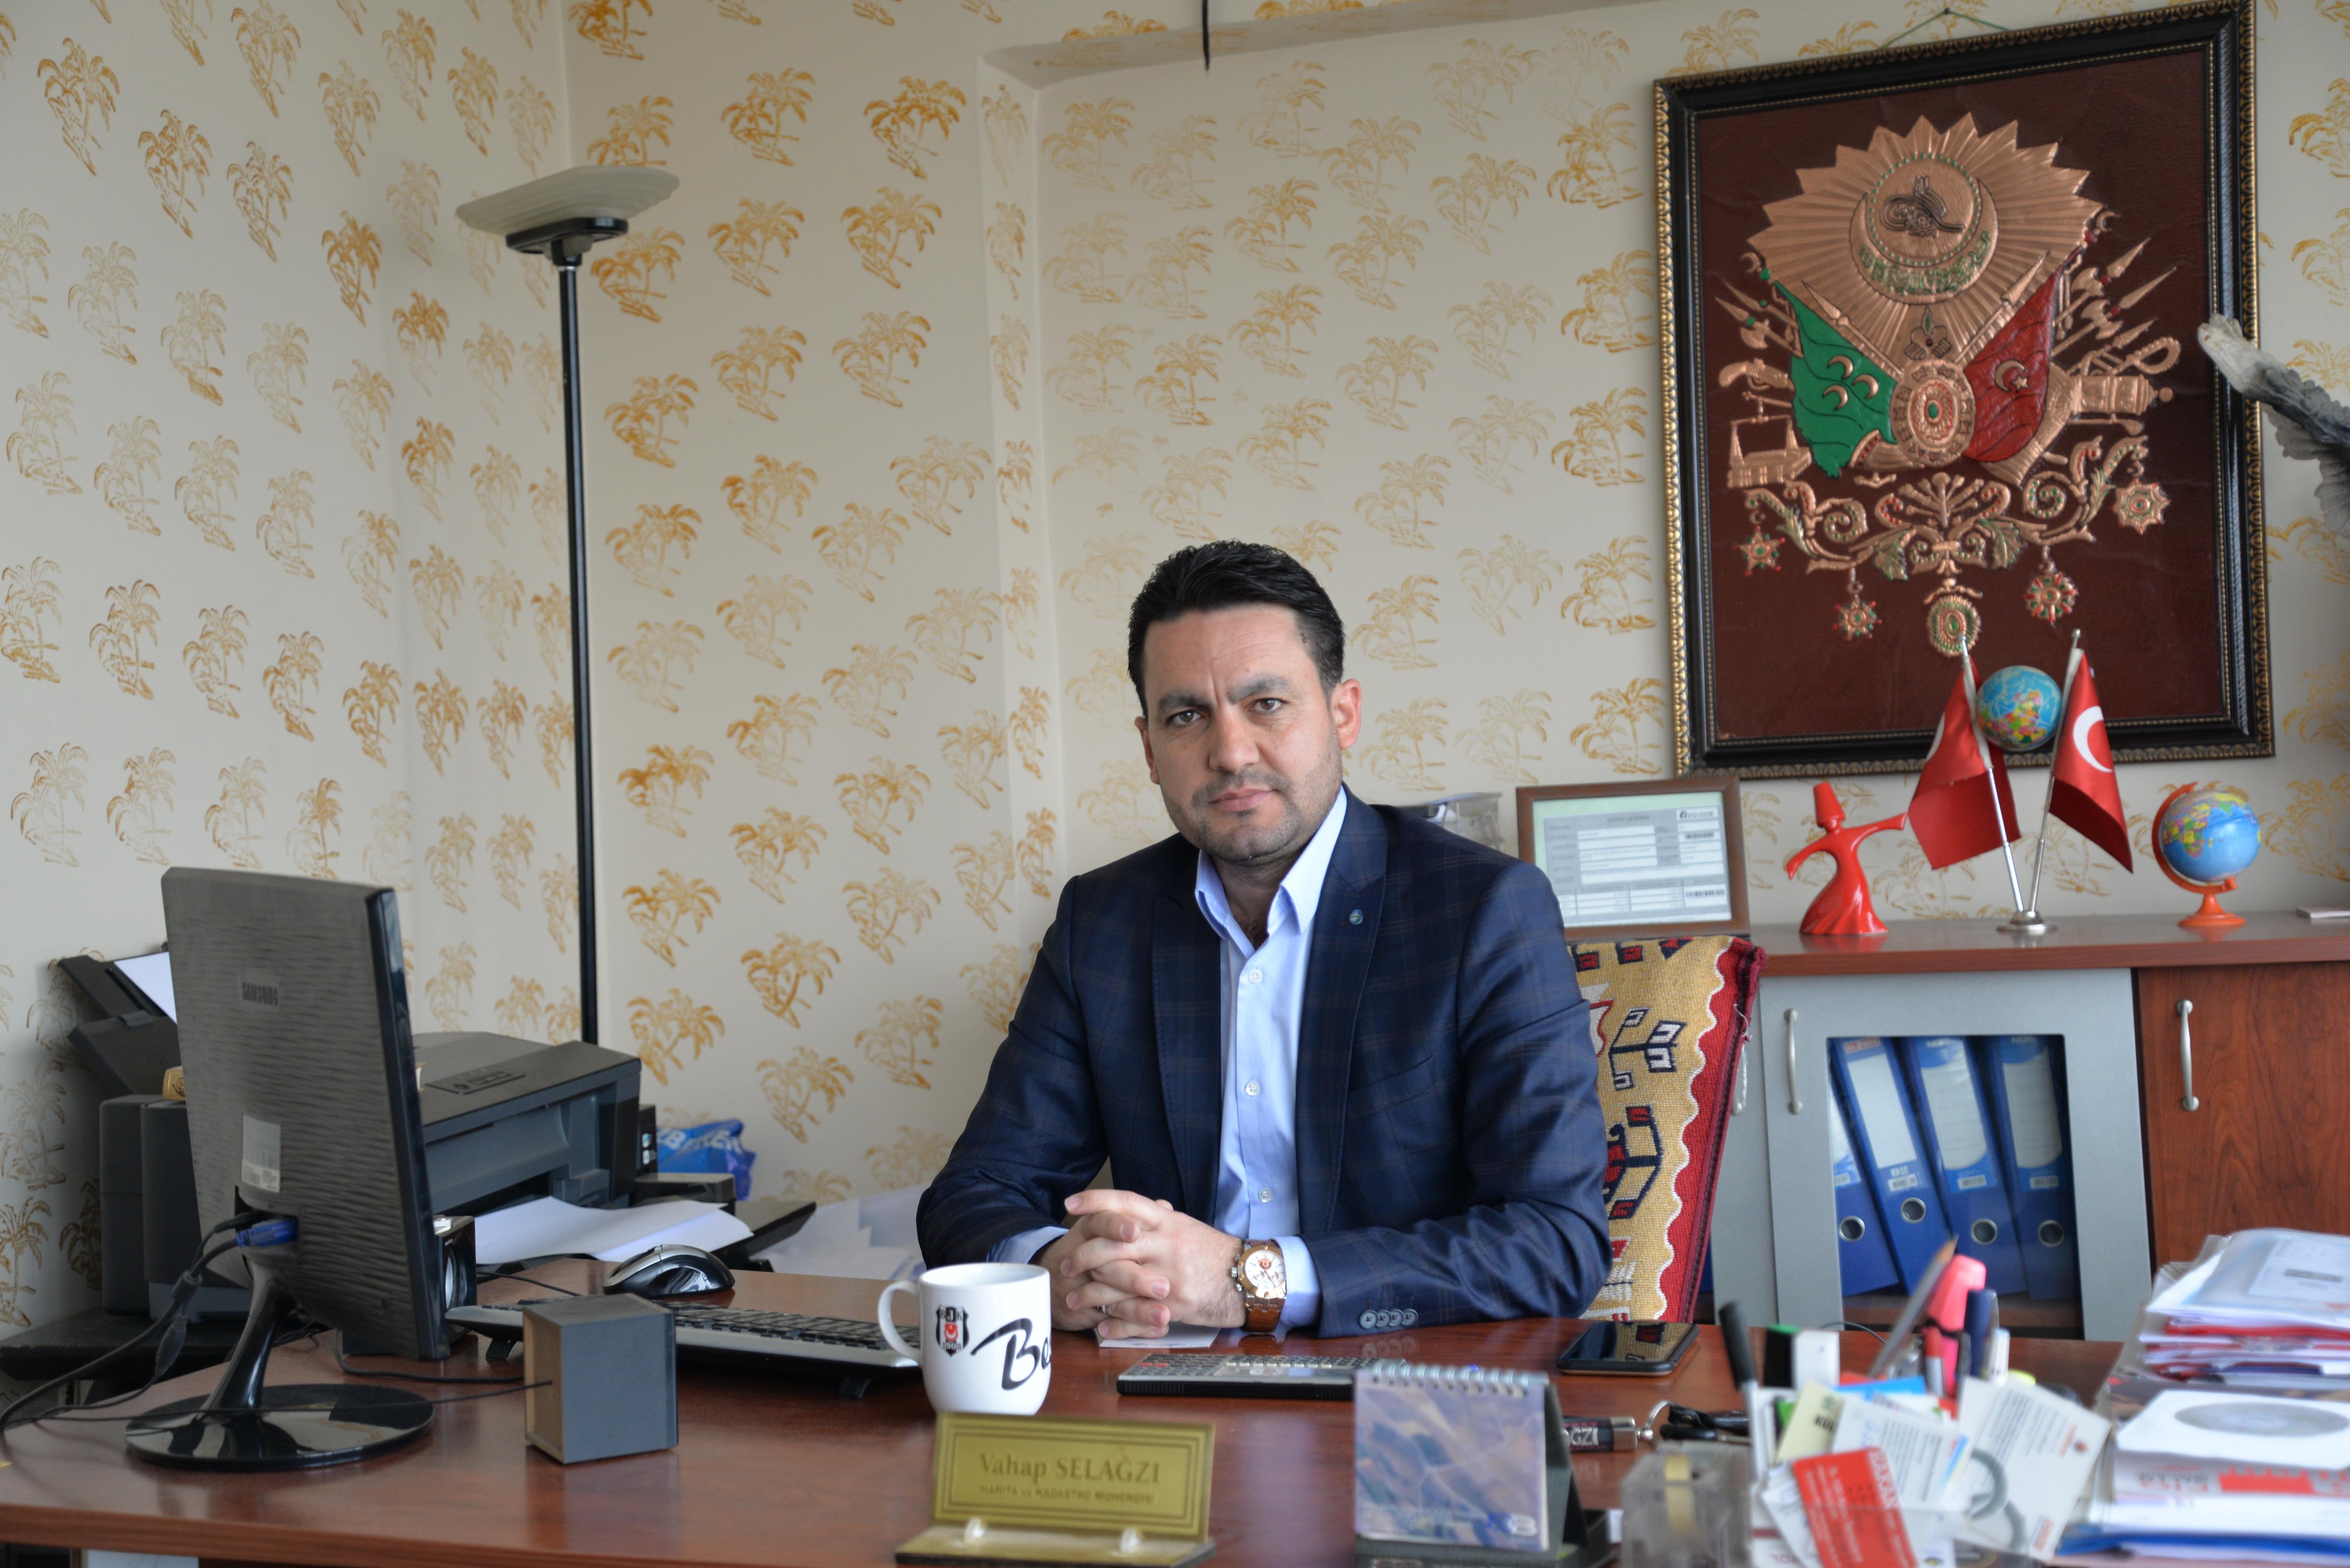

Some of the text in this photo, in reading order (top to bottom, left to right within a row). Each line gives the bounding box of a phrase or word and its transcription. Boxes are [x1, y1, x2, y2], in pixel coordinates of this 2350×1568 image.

[941, 1309, 963, 1321] BJK
[970, 1317, 1052, 1391] Be
[979, 1453, 1161, 1484] Vahap SELAĞZI
[1036, 1487, 1091, 1501] KADASTRO
